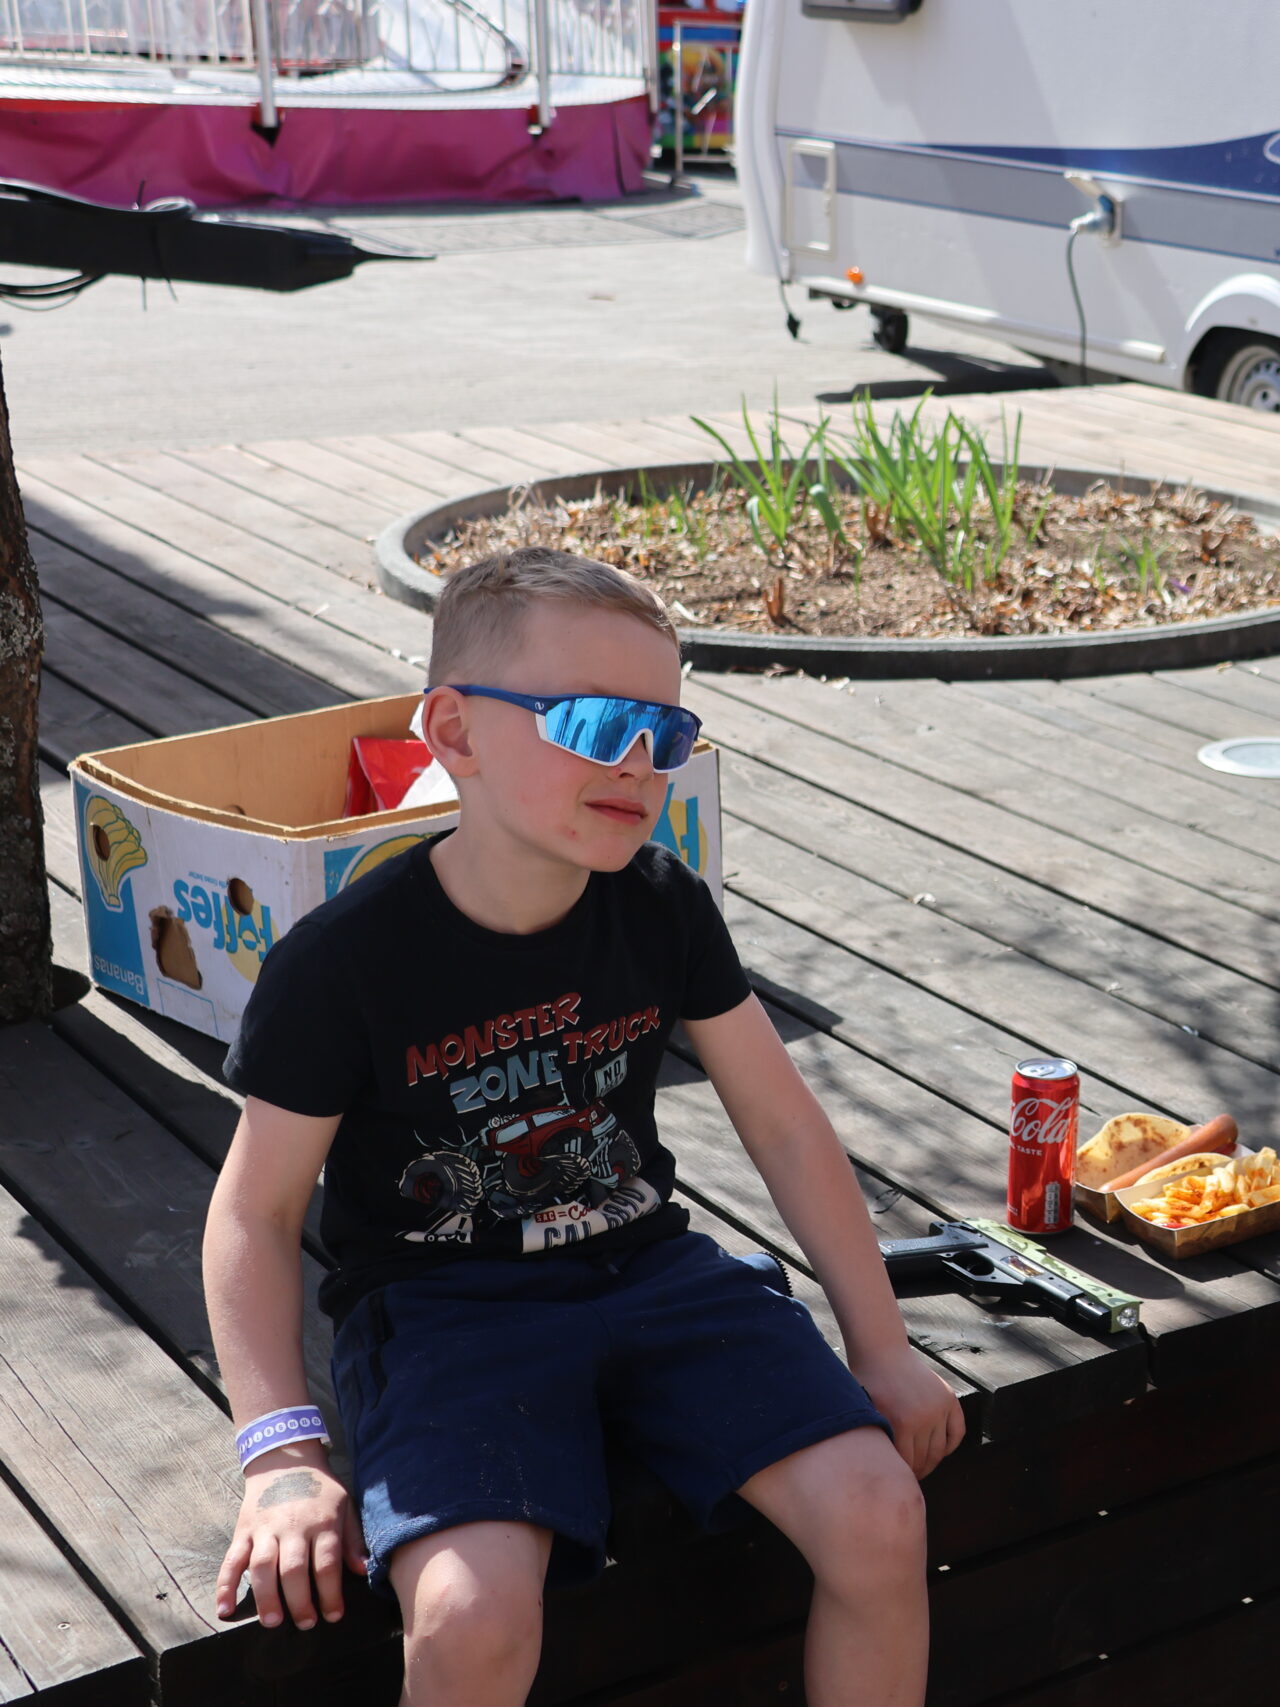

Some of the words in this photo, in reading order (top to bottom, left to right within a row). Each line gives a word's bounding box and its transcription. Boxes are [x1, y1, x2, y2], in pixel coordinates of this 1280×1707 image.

[94, 956, 145, 996] Bananas
[407, 992, 581, 1086] MONSTER
[563, 1006, 660, 1064] TRUCK
[450, 1050, 563, 1114] ZONE
[603, 1060, 621, 1085] NO
[1017, 1145, 1042, 1157] TASTE
